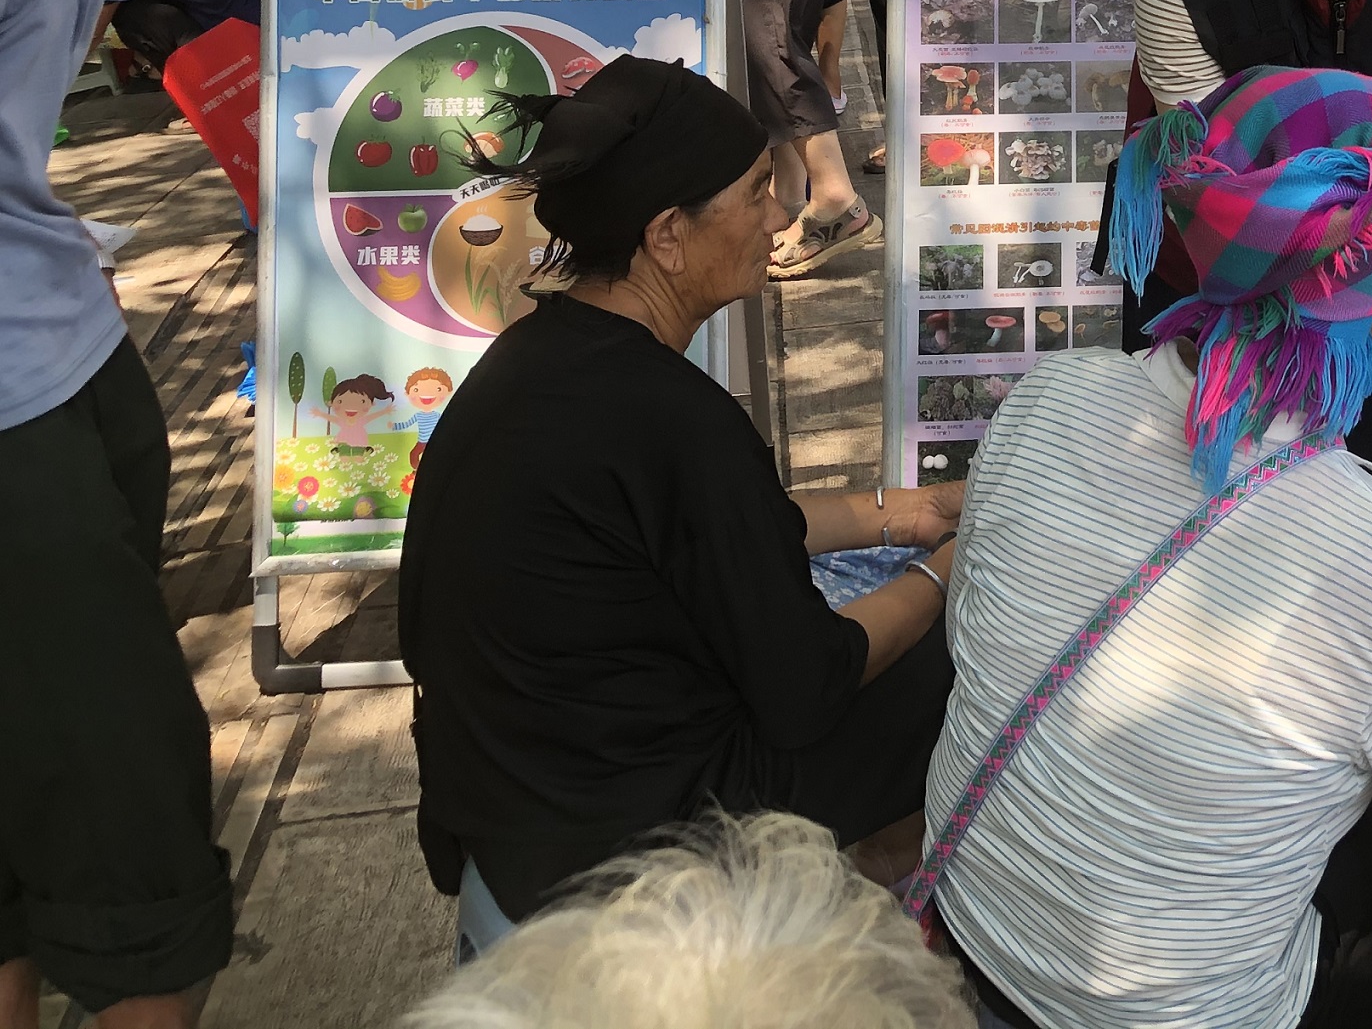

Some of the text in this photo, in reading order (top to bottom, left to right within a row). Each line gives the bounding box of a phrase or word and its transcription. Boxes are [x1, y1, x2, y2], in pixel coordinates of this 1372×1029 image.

[423, 96, 485, 119] 蔬菜类
[356, 245, 421, 268] 水果类
